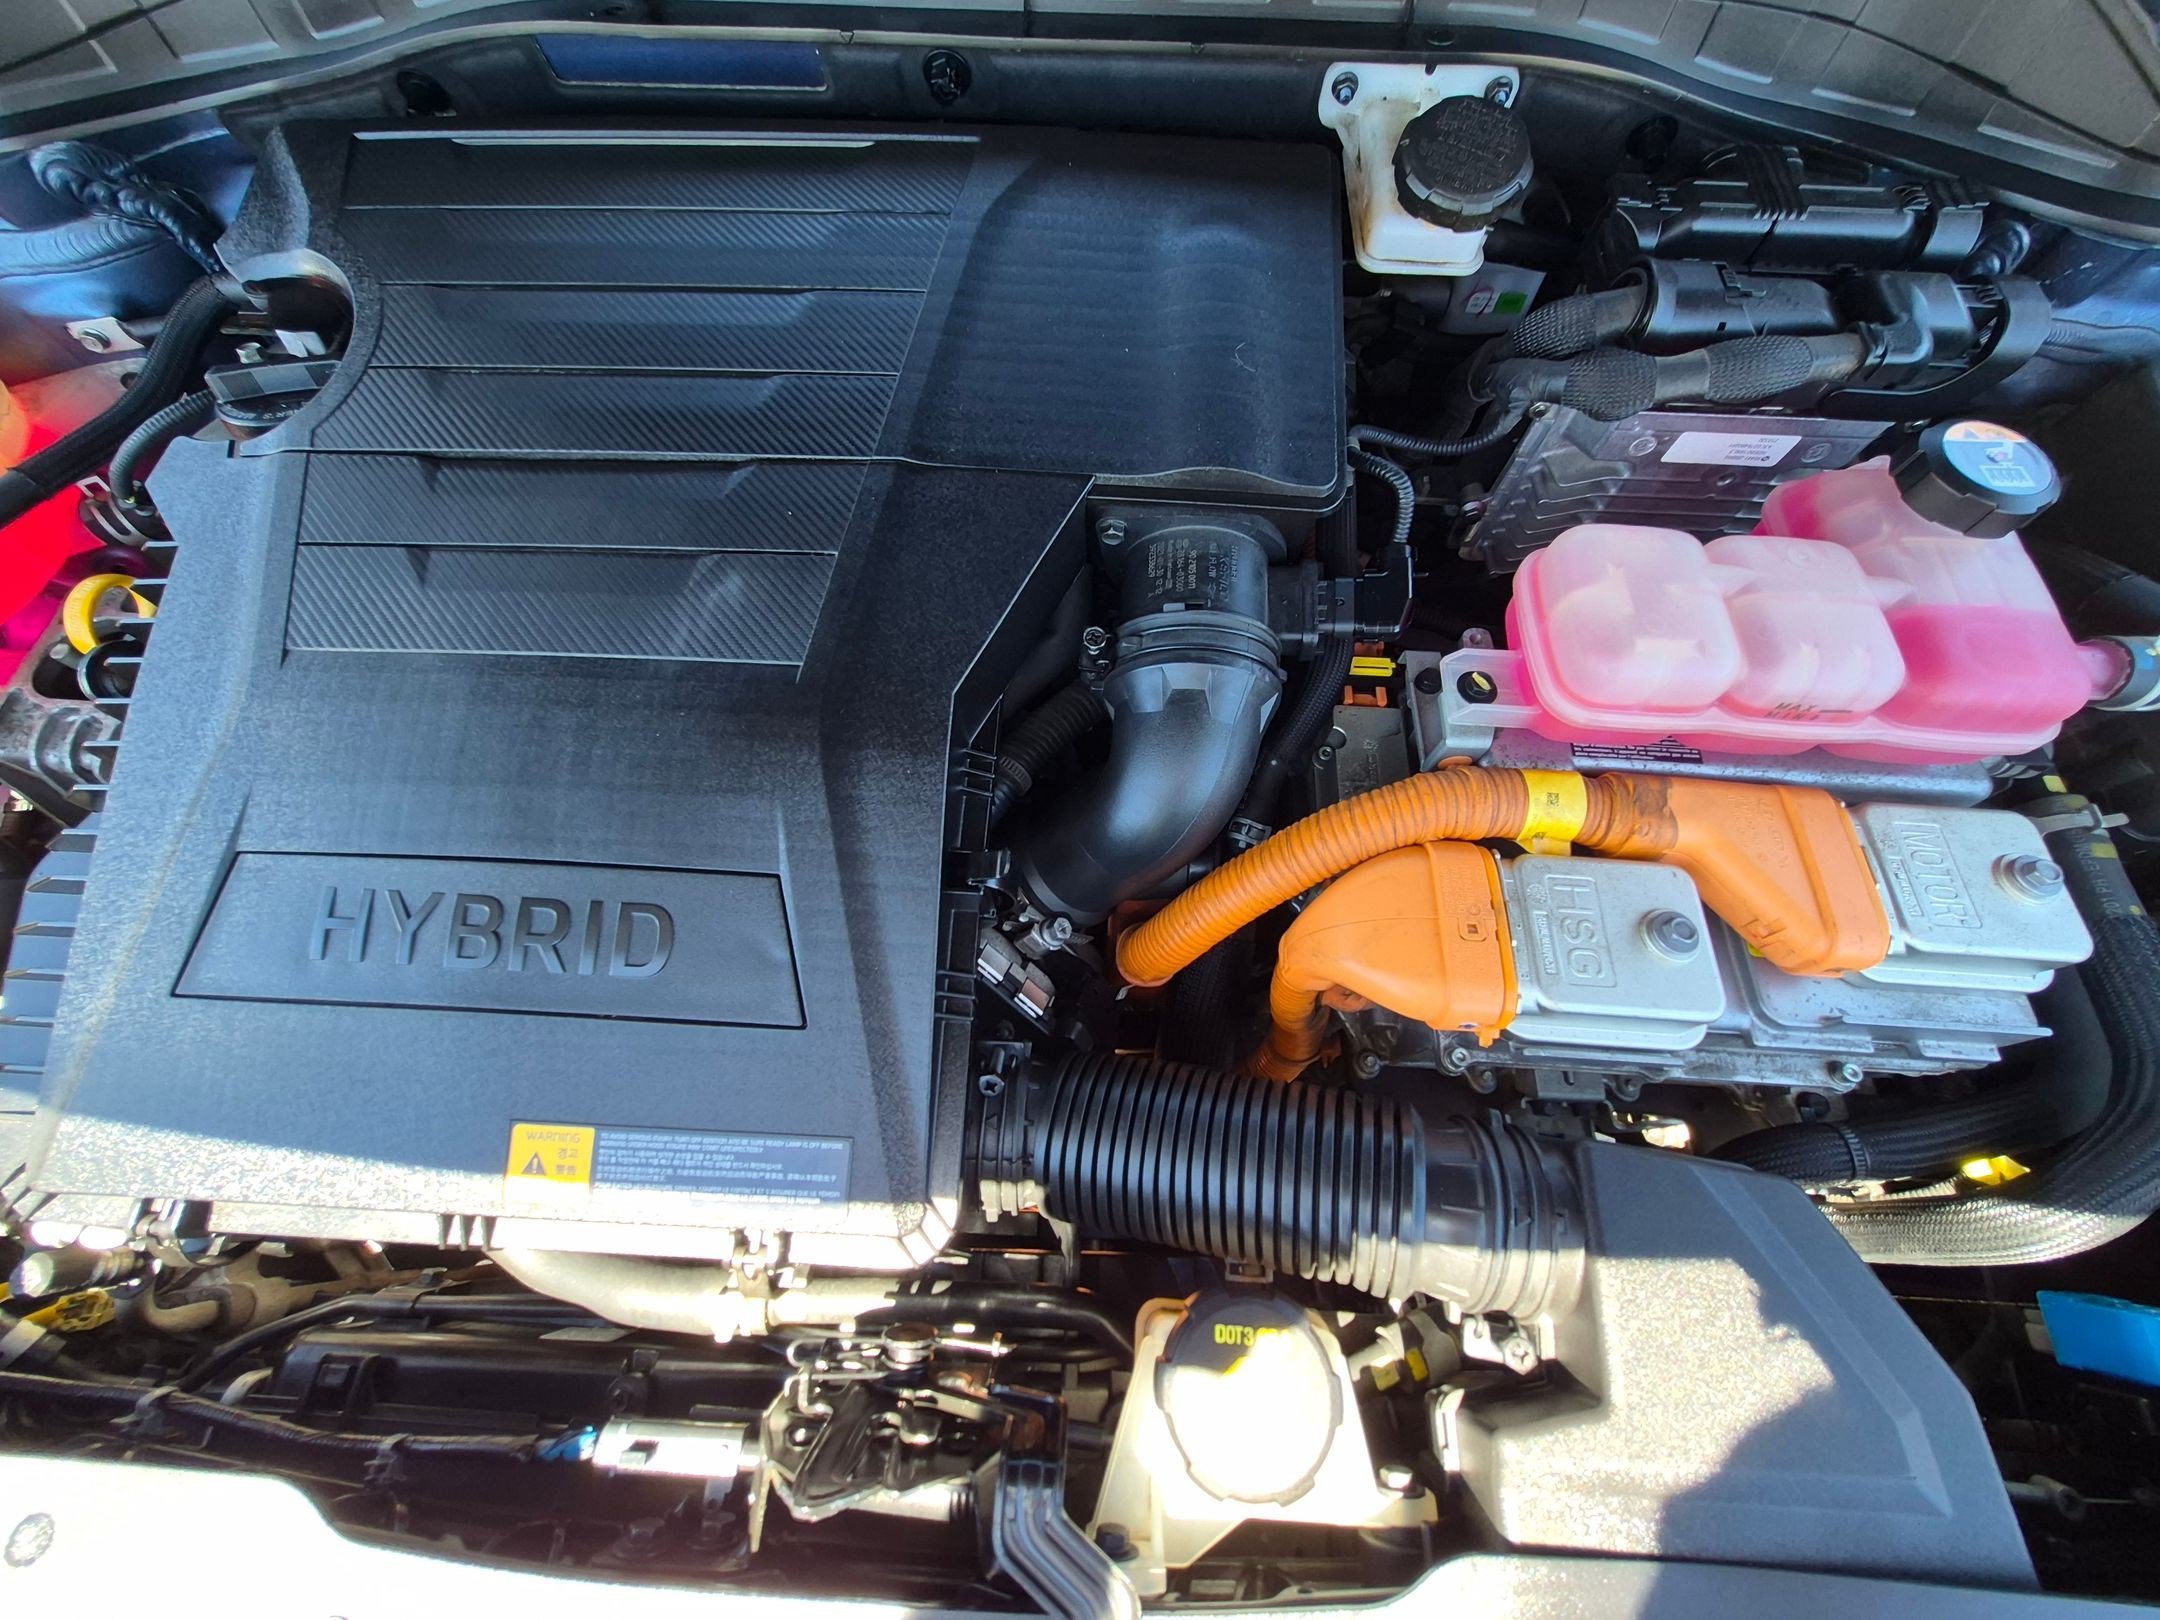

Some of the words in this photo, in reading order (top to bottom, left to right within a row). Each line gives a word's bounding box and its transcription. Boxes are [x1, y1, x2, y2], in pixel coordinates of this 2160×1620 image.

[1775, 702, 1819, 713] MAX
[1901, 830, 1969, 922] MOTOR
[309, 886, 675, 978] HYBRID
[1553, 884, 1606, 979] HSG
[765, 1140, 784, 1148] READY
[1214, 1323, 1255, 1347] DOT3
